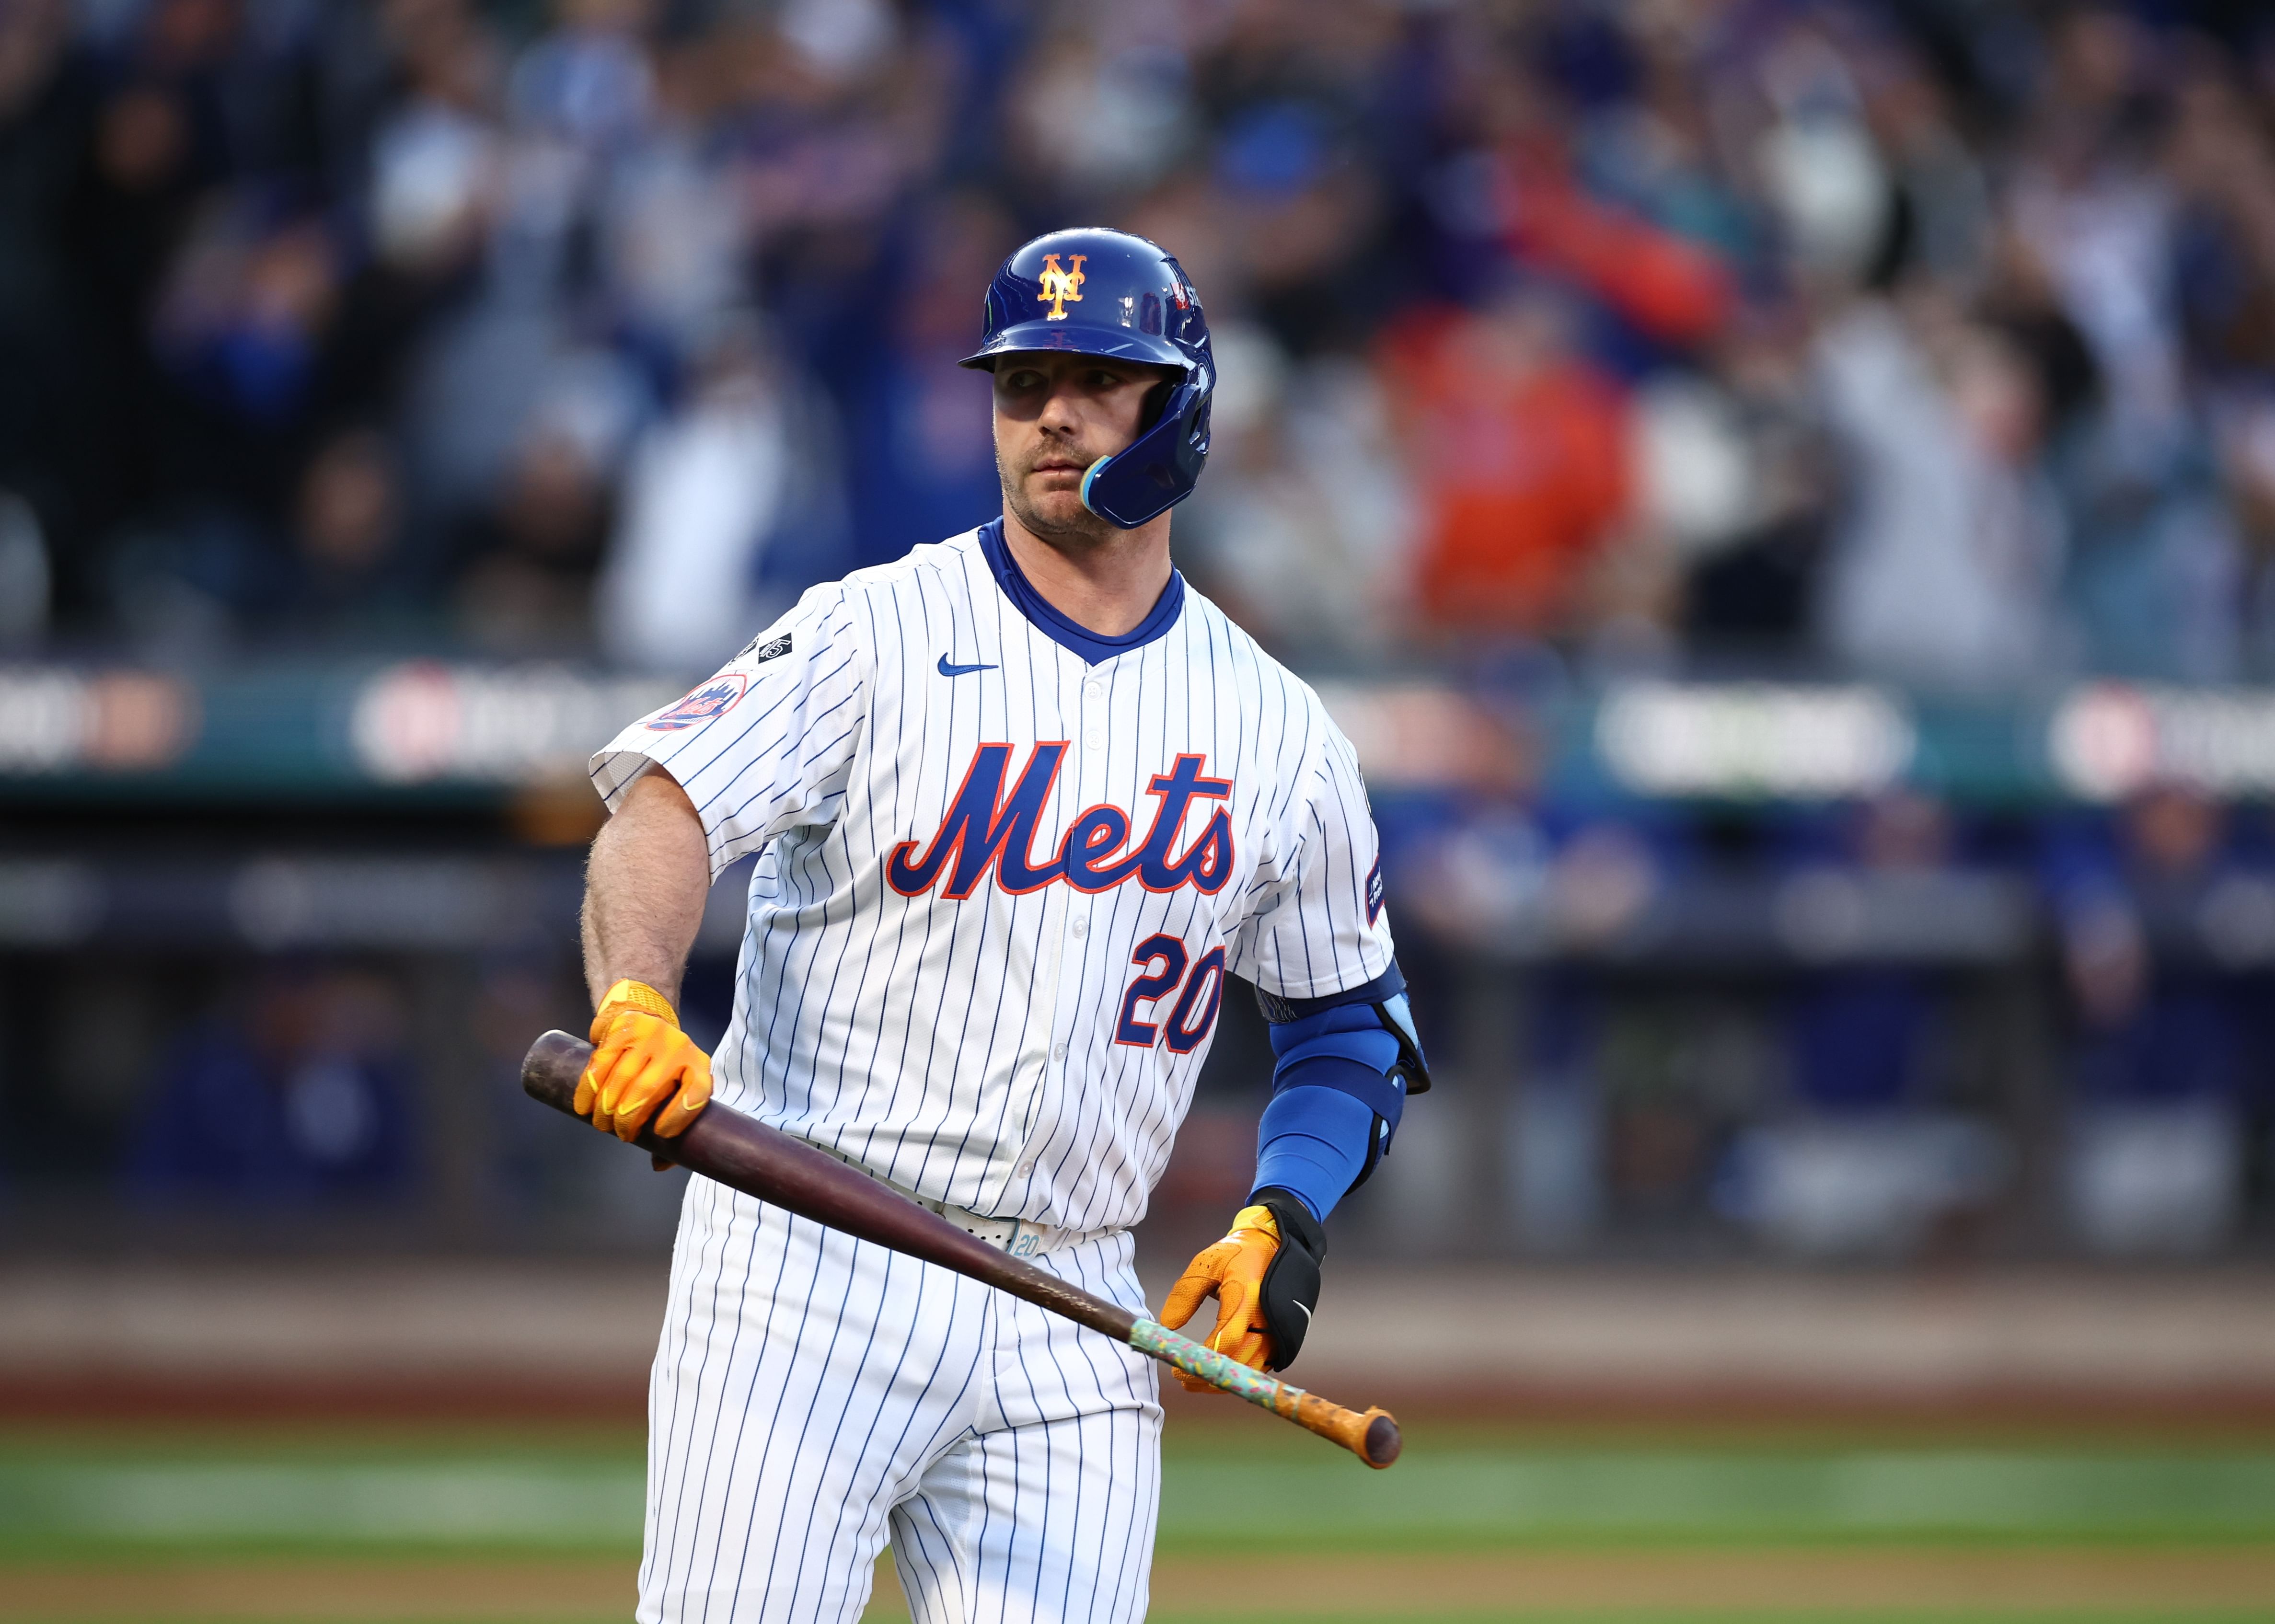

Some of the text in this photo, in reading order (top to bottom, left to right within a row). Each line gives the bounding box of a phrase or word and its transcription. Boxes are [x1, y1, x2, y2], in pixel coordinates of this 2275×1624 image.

[885, 740, 1235, 900] Mets
[1114, 933, 1226, 1054] 20
[1014, 1234, 1039, 1256] 20
